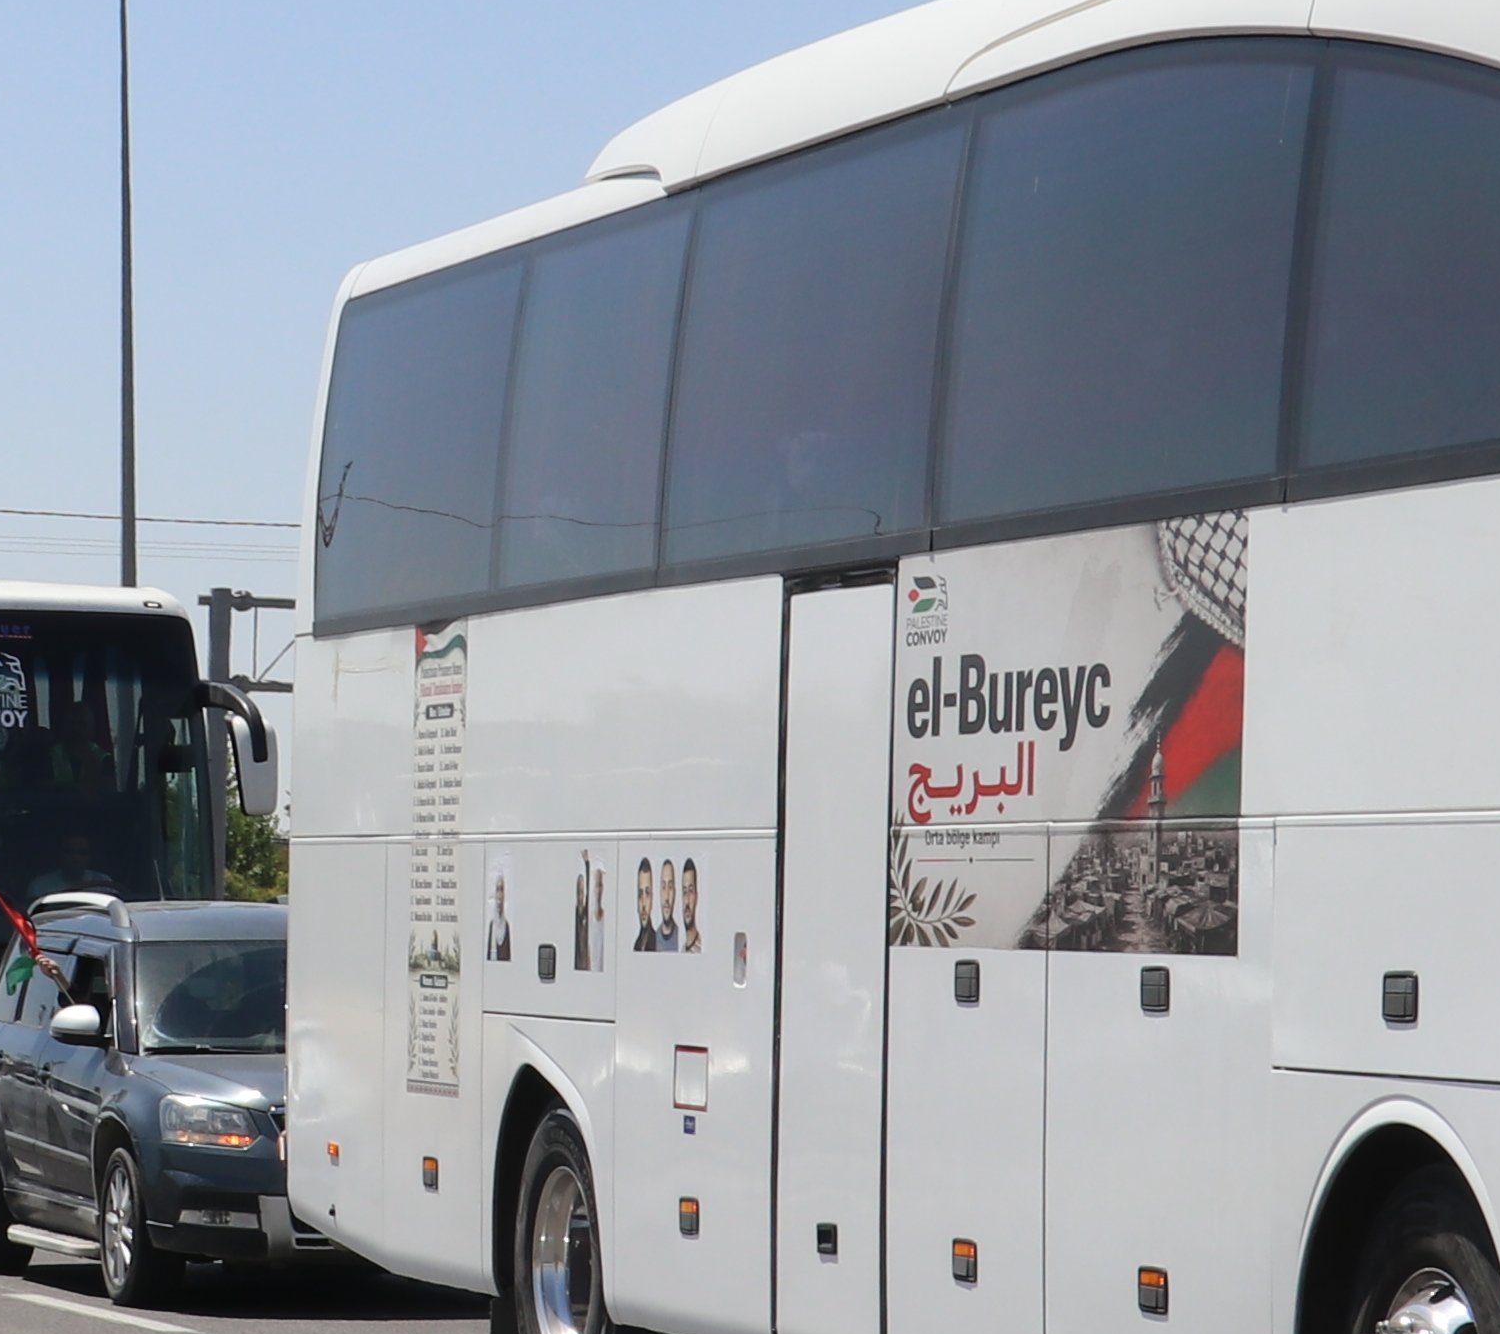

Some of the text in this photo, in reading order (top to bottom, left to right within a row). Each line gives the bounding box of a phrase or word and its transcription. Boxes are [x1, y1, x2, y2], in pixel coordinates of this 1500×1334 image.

[907, 614, 948, 630] PALESTINE
[906, 628, 948, 647] CONVOY
[907, 654, 1111, 751] el-Bureyc
[908, 741, 1035, 823] البريج
[925, 830, 944, 845] Orta
[946, 829, 970, 849] bölge
